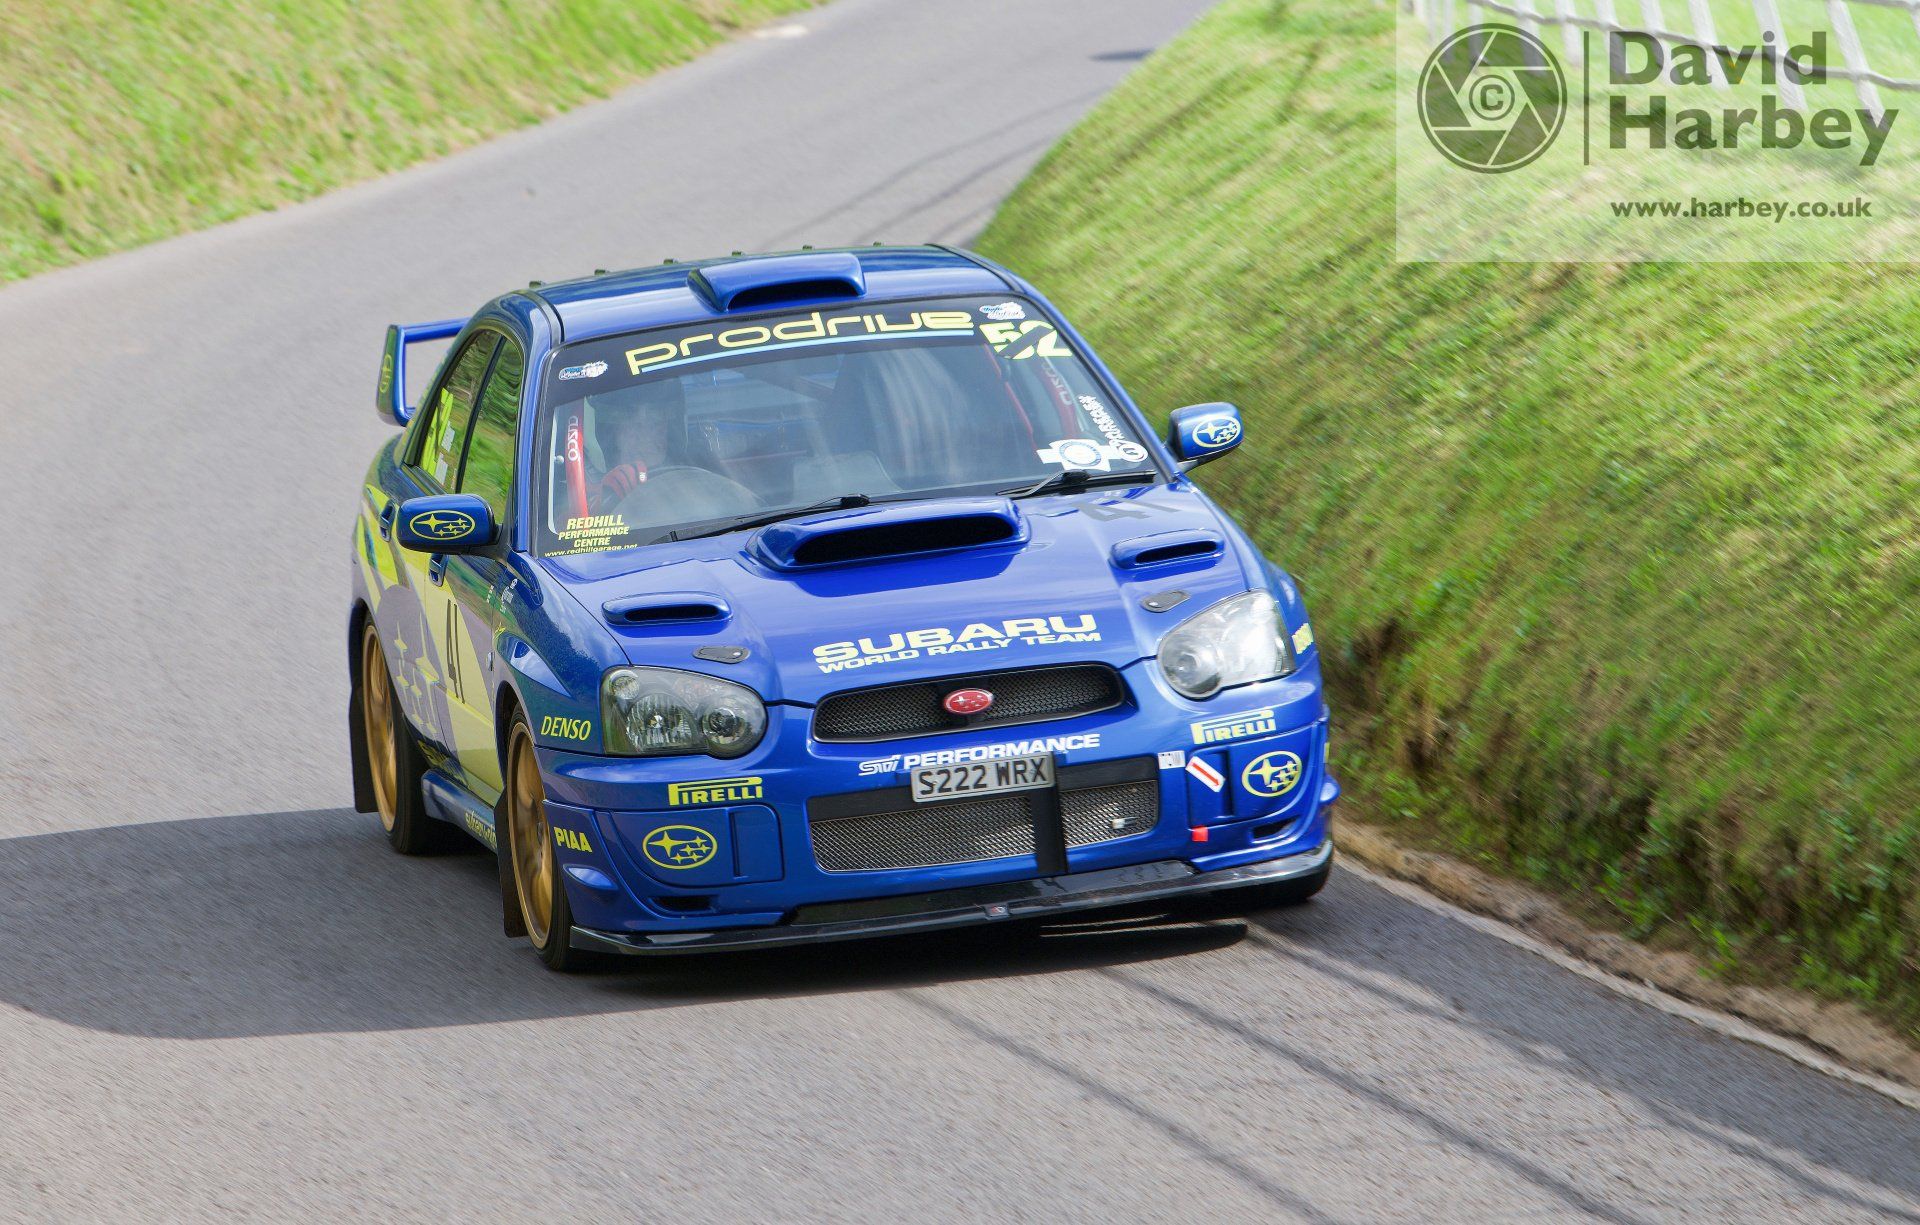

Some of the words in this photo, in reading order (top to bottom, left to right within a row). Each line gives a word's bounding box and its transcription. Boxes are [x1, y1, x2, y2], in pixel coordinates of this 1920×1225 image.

[979, 320, 1073, 360] 52
[558, 526, 630, 541] PERFORMANCE
[566, 514, 625, 530] REDHILL
[573, 537, 612, 548] CENTRE
[446, 598, 466, 705] 41
[812, 614, 1098, 664] SUBARU
[818, 648, 920, 674] WORLD
[925, 637, 1016, 657] RALLY
[1020, 632, 1102, 647] TEAM
[540, 715, 592, 742] DENSO
[1190, 710, 1277, 745] PIRELLI
[903, 733, 1101, 770] PERFORMANCE
[668, 777, 763, 806] PIRELLI
[918, 766, 988, 796] S222
[996, 757, 1048, 786] WRX
[553, 826, 593, 853] PIAA
